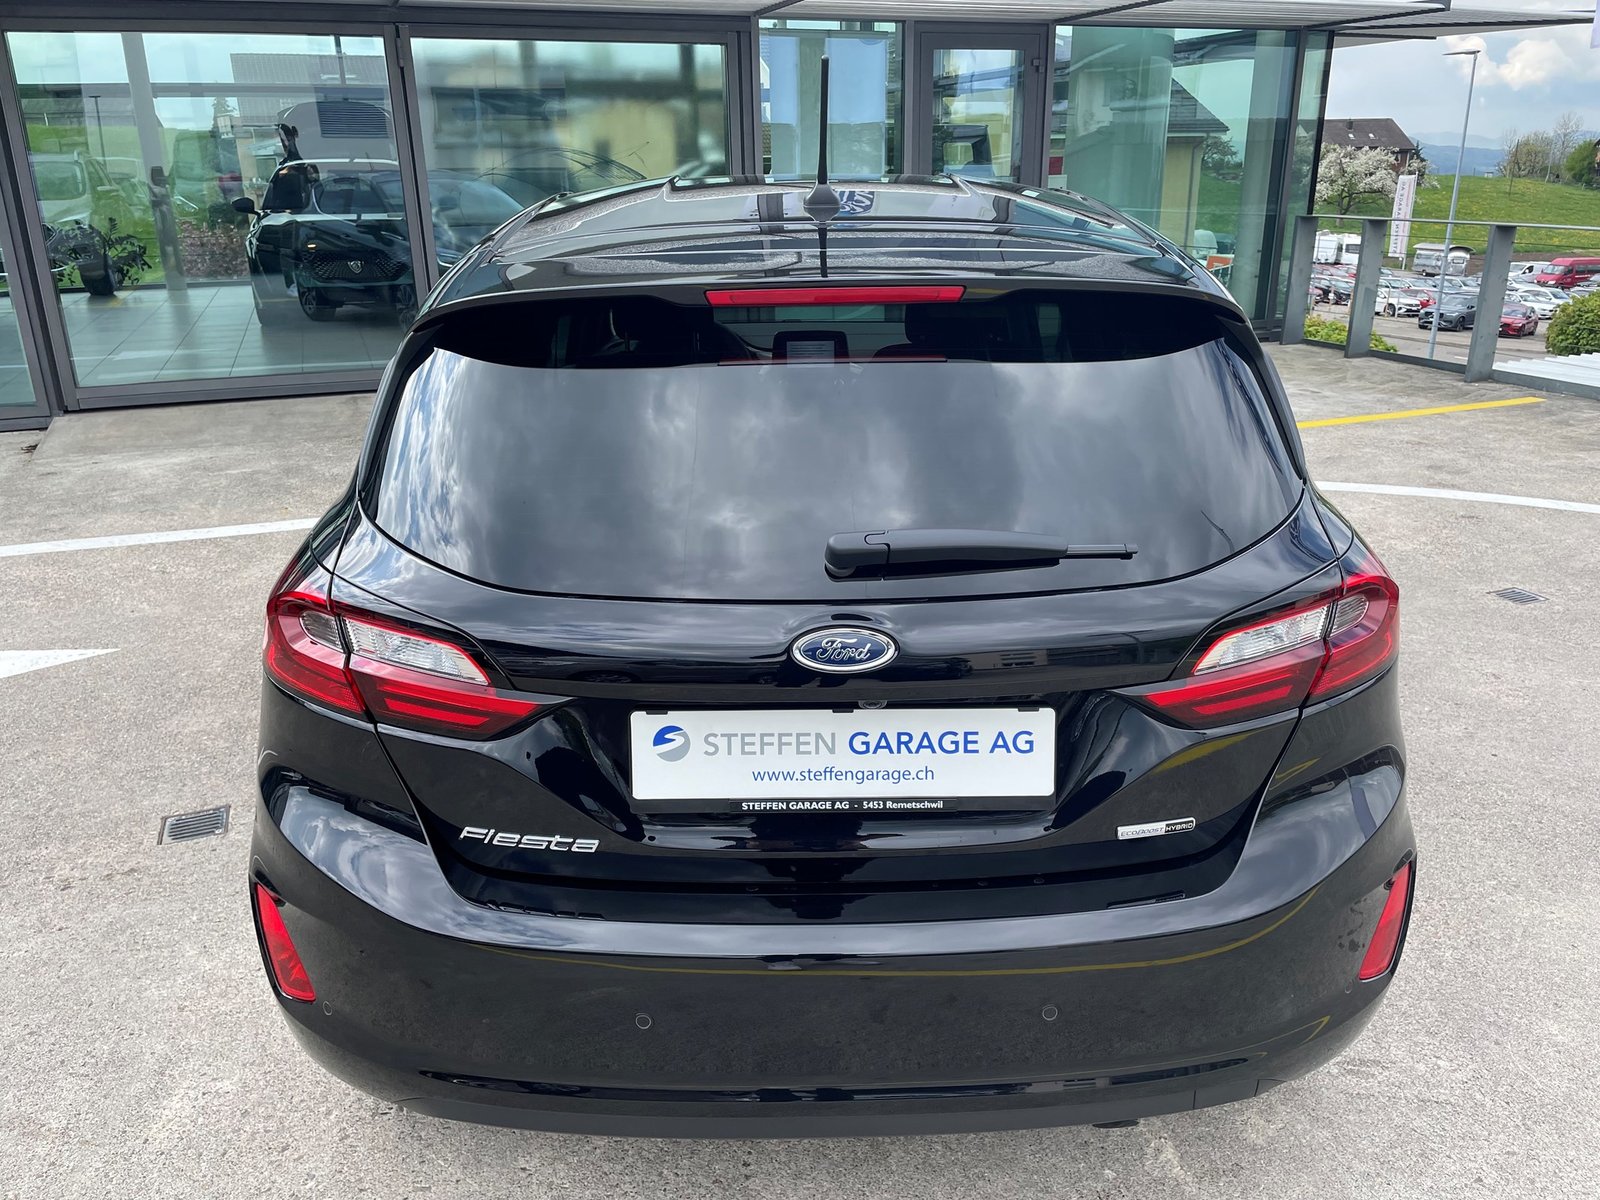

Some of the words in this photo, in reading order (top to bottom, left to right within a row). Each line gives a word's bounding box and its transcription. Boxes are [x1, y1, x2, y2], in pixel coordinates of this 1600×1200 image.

[816, 637, 872, 661] Ford
[703, 732, 836, 757] STEFFEN
[848, 731, 980, 756] GARAGE
[988, 730, 1035, 754] AG
[751, 766, 935, 785] www.steffengarage.ch
[741, 801, 787, 811] STEFFEN
[789, 801, 832, 811] GARAGE
[833, 801, 850, 810] AG
[863, 800, 883, 809] 5453
[886, 799, 944, 810] Remetschwil
[1165, 822, 1194, 832] HYBRID
[459, 826, 600, 853] Fiesta
